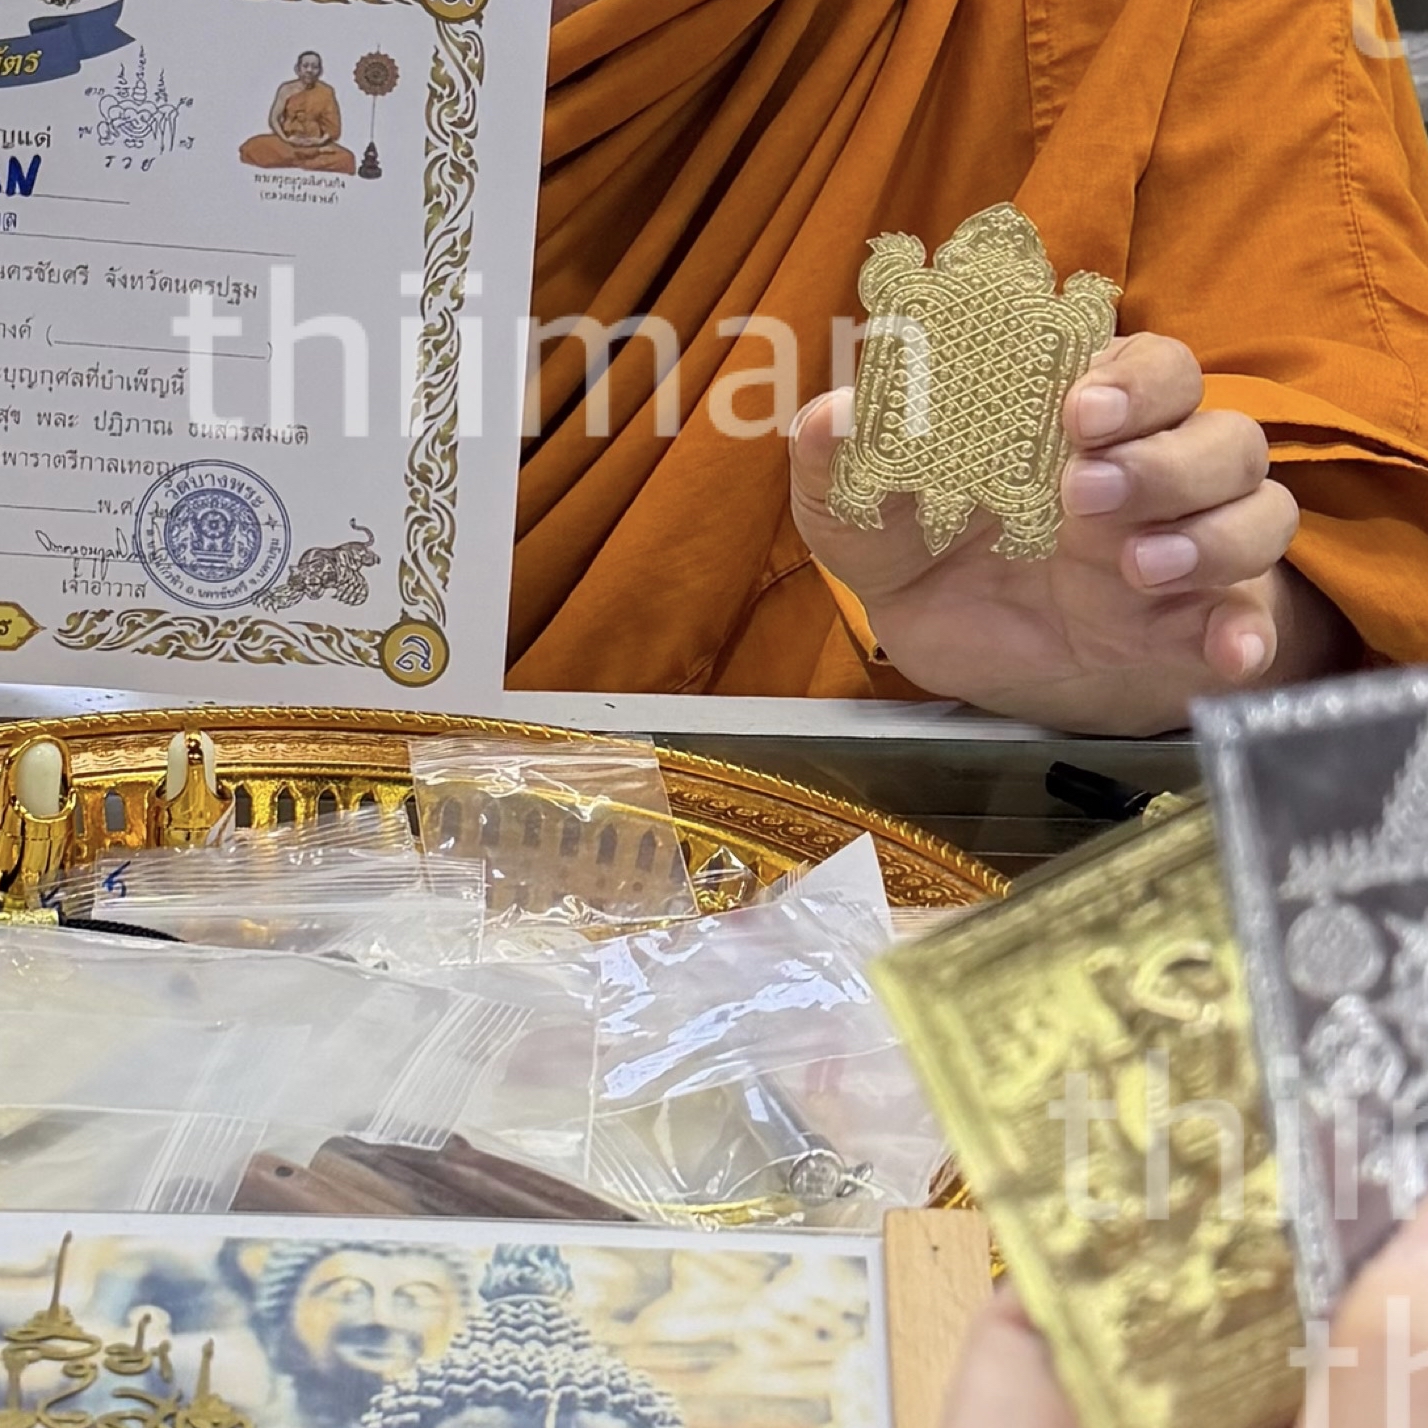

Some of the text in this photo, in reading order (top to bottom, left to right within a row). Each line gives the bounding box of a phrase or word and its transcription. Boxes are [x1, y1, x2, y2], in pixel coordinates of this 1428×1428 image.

[104, 267, 258, 305] จังหวัดนครปฐม
[36, 410, 80, 429] พละ
[93, 410, 174, 438] ปฏิภาณ
[62, 575, 148, 599] เจ้าอาวาส
